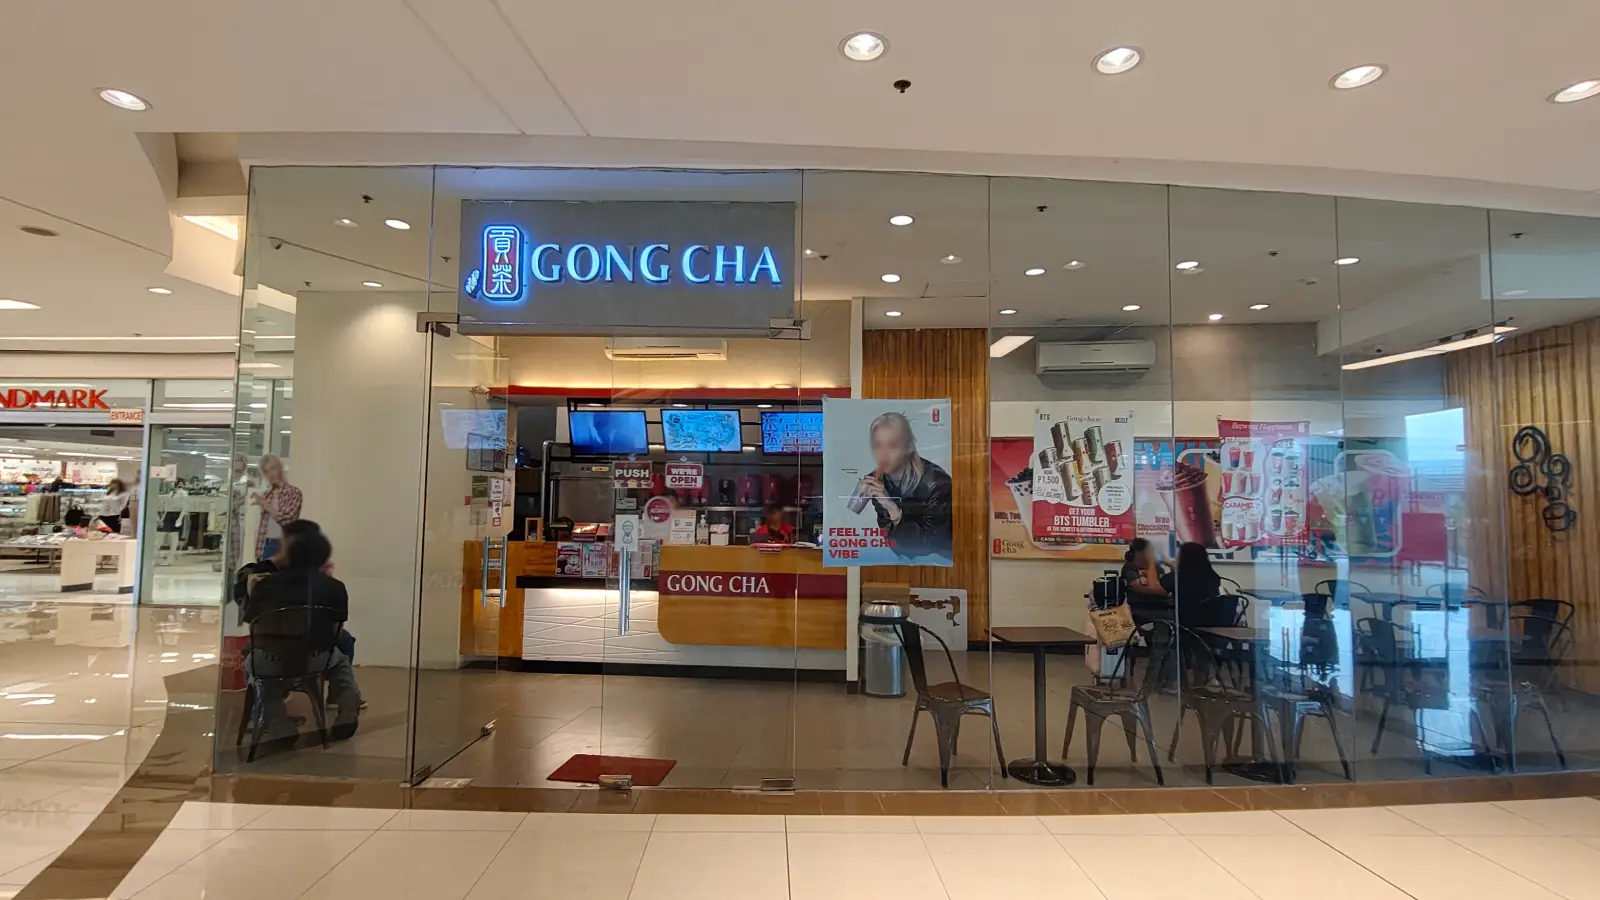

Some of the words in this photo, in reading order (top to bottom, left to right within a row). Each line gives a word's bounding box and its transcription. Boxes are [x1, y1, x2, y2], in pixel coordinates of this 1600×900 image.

[531, 243, 671, 284] GONG
[681, 244, 782, 285] CHA
[111, 411, 142, 421] ENTRANCE
[615, 468, 649, 478] PUSH
[670, 476, 698, 484] OPEN
[1068, 507, 1079, 515] GET
[1054, 515, 1070, 526] BTS
[1071, 516, 1110, 527] TUMBLER
[829, 527, 860, 537] FEEL
[861, 528, 888, 537] THE
[829, 538, 868, 548] GONG
[1002, 539, 1025, 549] Gong
[829, 549, 859, 559] VIBE
[1002, 546, 1017, 554] cha
[667, 574, 723, 593] GONG
[728, 576, 770, 594] CHA
